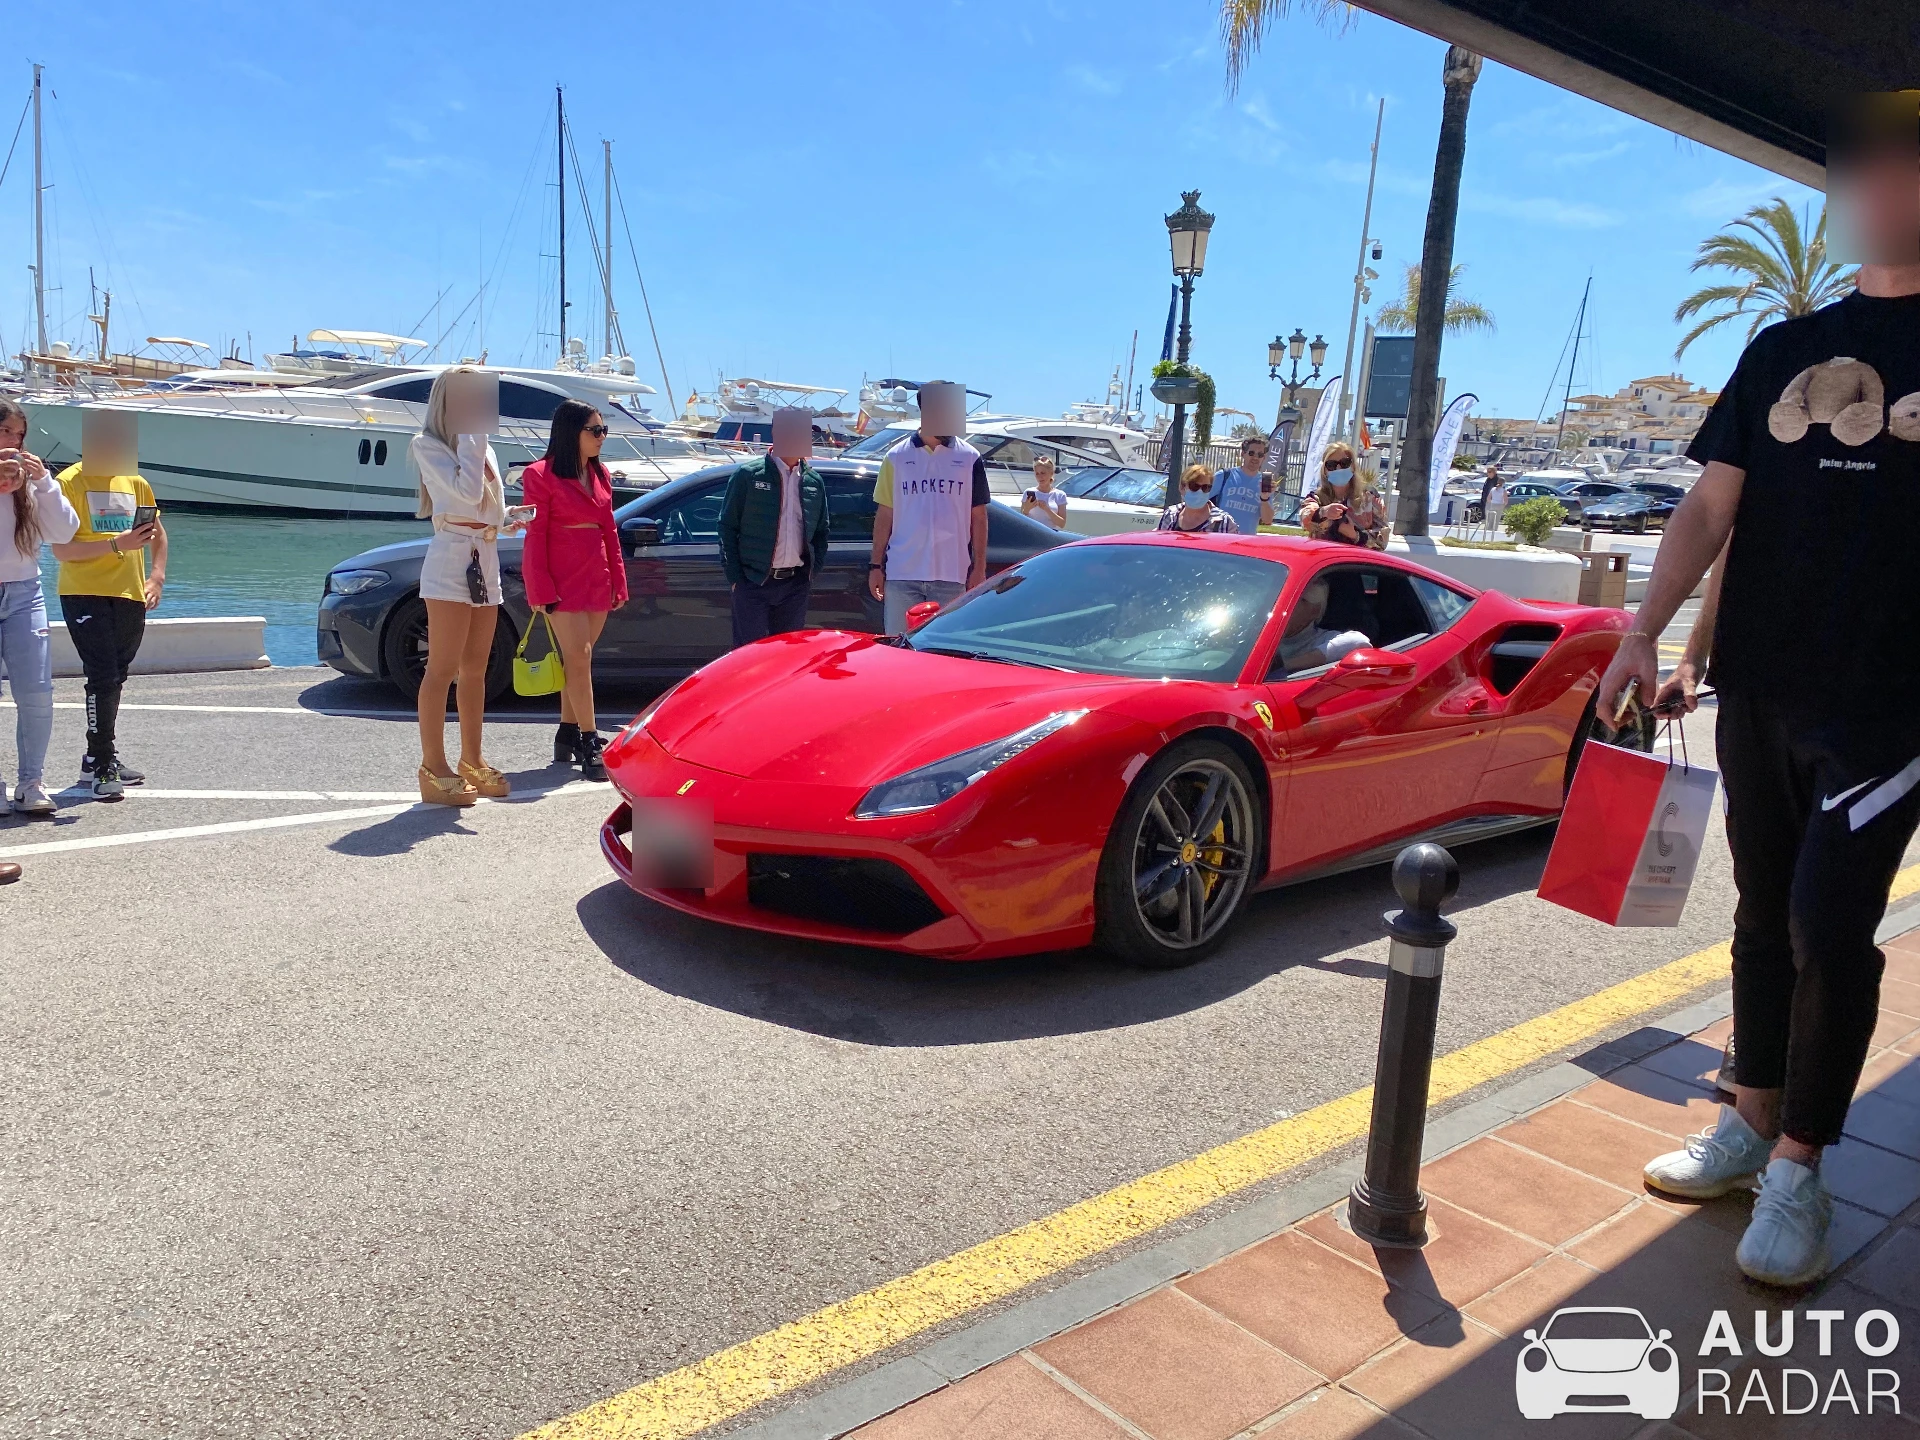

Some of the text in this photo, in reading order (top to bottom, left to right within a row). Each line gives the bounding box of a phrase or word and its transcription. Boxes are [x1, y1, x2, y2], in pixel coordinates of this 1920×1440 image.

[1438, 418, 1458, 455] SALE
[1267, 445, 1282, 468] ME
[902, 478, 964, 496] HACKETT
[1227, 487, 1260, 502] BOSS
[95, 520, 118, 530] WALK
